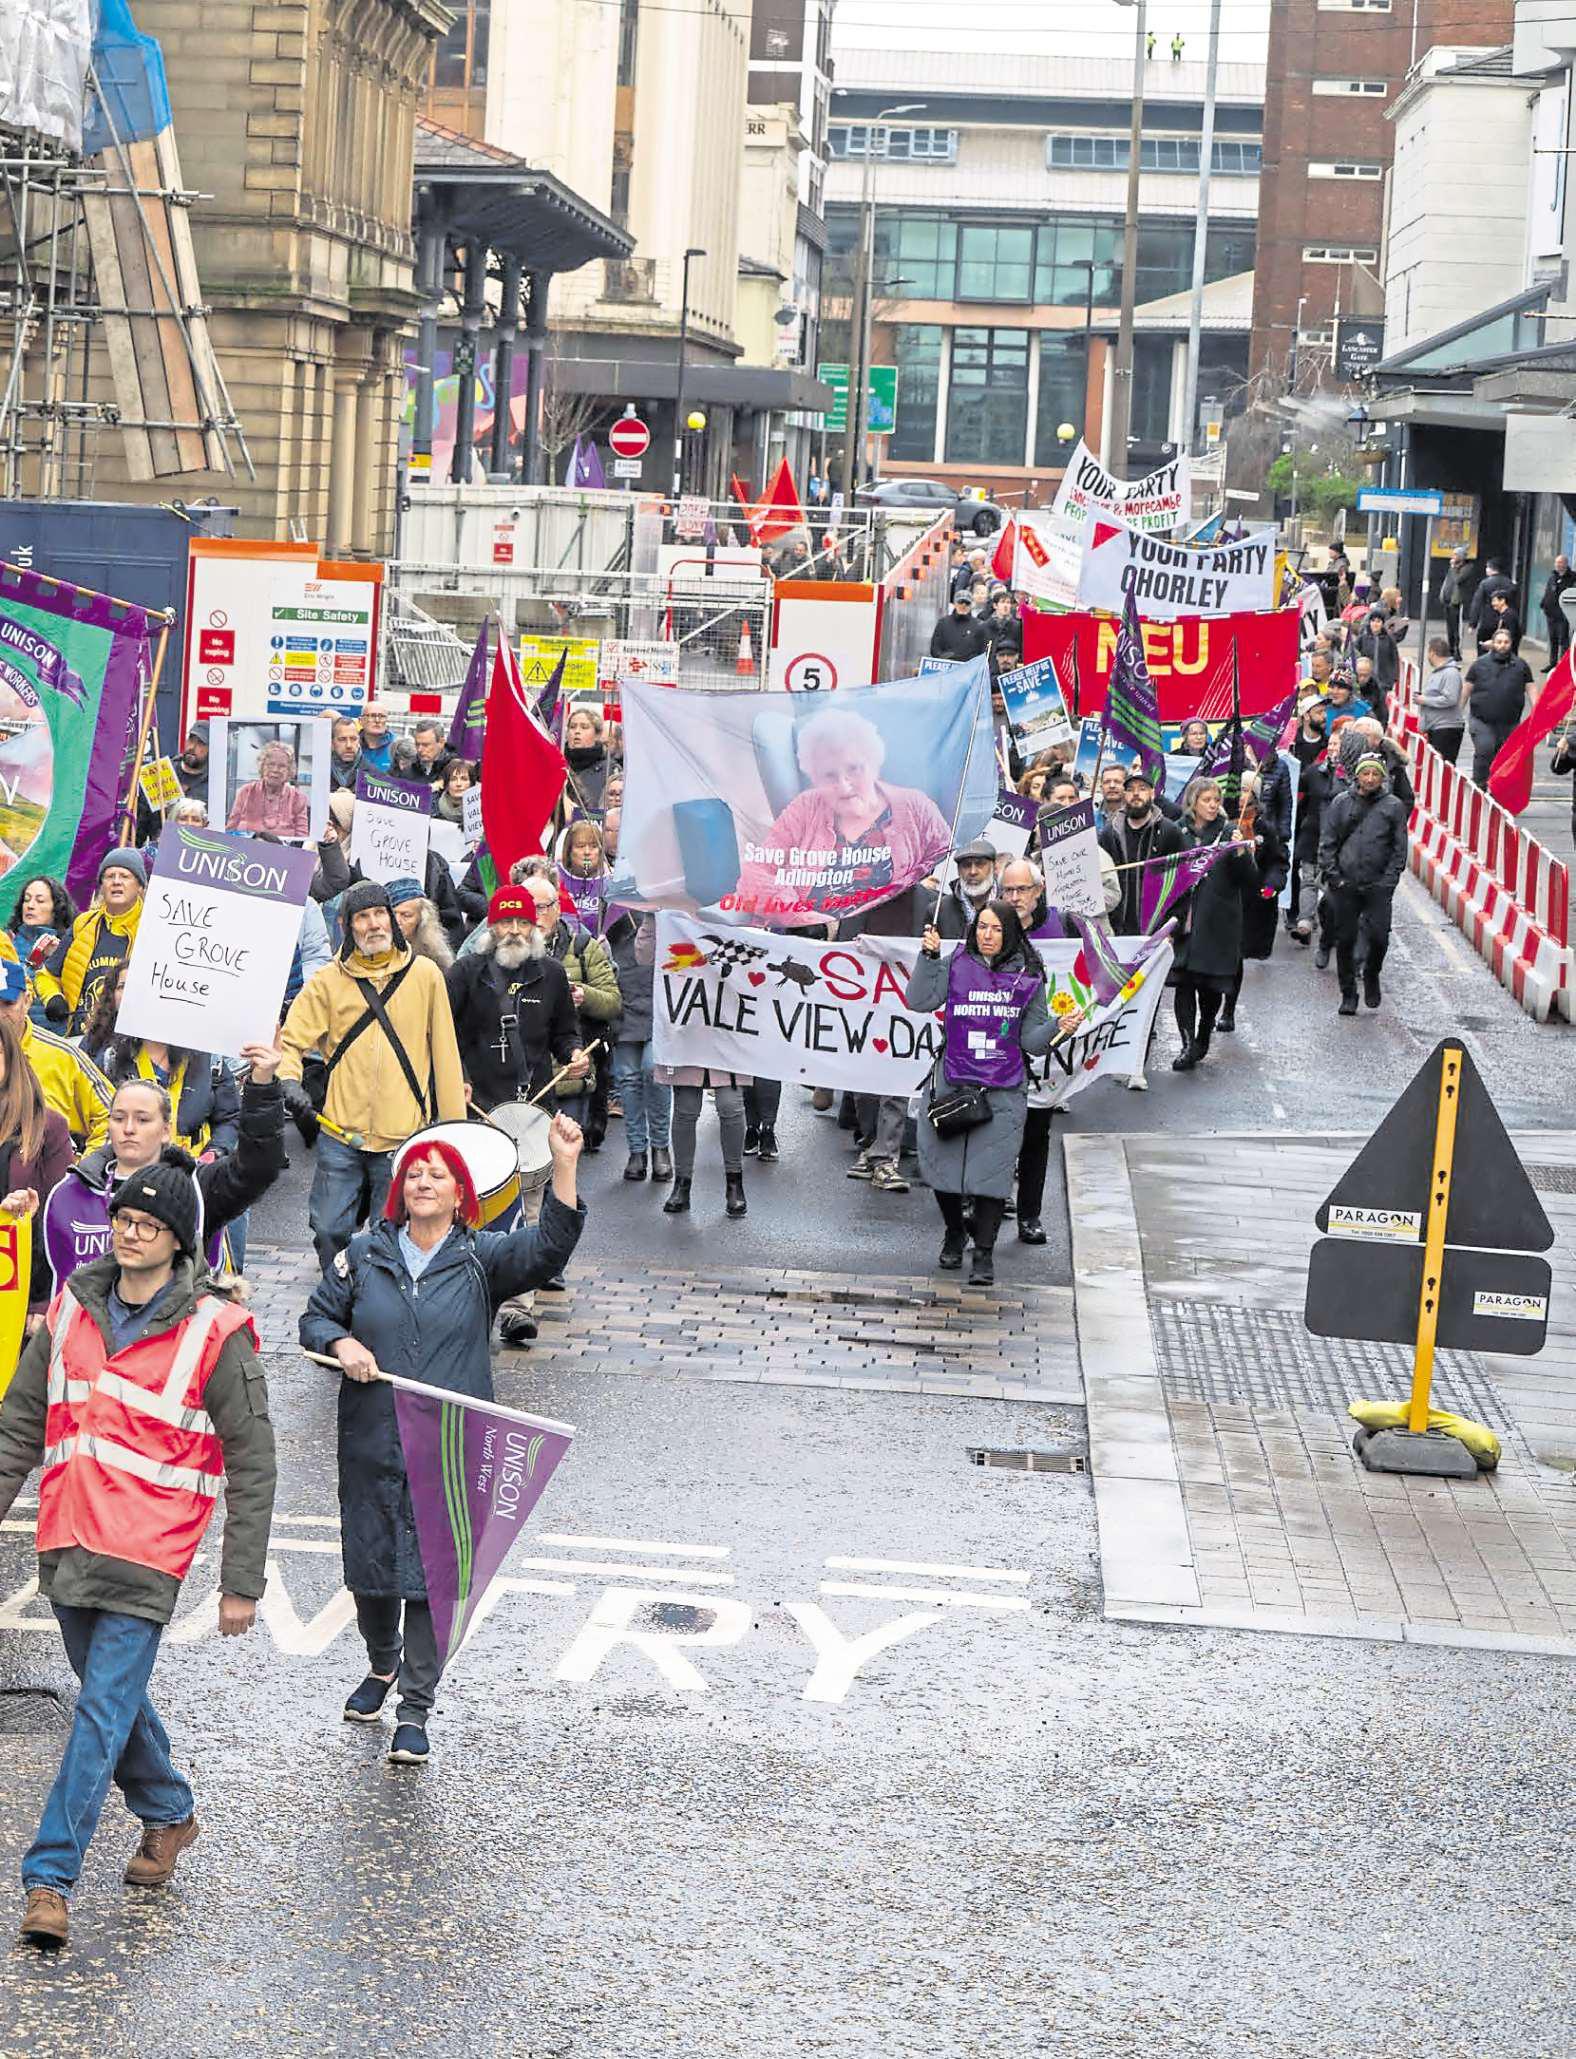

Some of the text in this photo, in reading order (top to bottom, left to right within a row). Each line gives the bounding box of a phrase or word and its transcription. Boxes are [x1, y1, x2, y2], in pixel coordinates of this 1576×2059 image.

[1076, 456, 1116, 499] YOUR
[1121, 564, 1228, 608] CHORLEY
[297, 609, 359, 623] Site Safety
[1, 623, 57, 670] UNISON
[211, 638, 224, 646] No
[1096, 622, 1209, 675] NEU
[4, 664, 39, 707] WORKERS
[803, 667, 820, 691] 5
[1016, 675, 1042, 694] SAVE
[208, 695, 220, 704] No
[366, 785, 420, 808] UNISON
[1047, 813, 1086, 840] UNISON
[744, 842, 892, 867] Save Grove House
[178, 848, 288, 892] UNISON
[775, 867, 854, 888] Adlington
[159, 893, 218, 928] SAVE
[719, 892, 757, 913] Old
[762, 895, 814, 913] lives
[175, 932, 251, 972] GROVE
[151, 962, 210, 997] House
[968, 989, 1010, 1003] UNISON
[663, 974, 760, 1036] VALE
[772, 999, 875, 1054] VIEW
[953, 1004, 1021, 1018] NORTH WEST
[1335, 1208, 1414, 1226] PARAGON
[1480, 1293, 1541, 1309] PARAGON
[482, 1424, 498, 1461] North
[477, 1463, 493, 1493] West
[494, 1431, 528, 1520] UNISON
